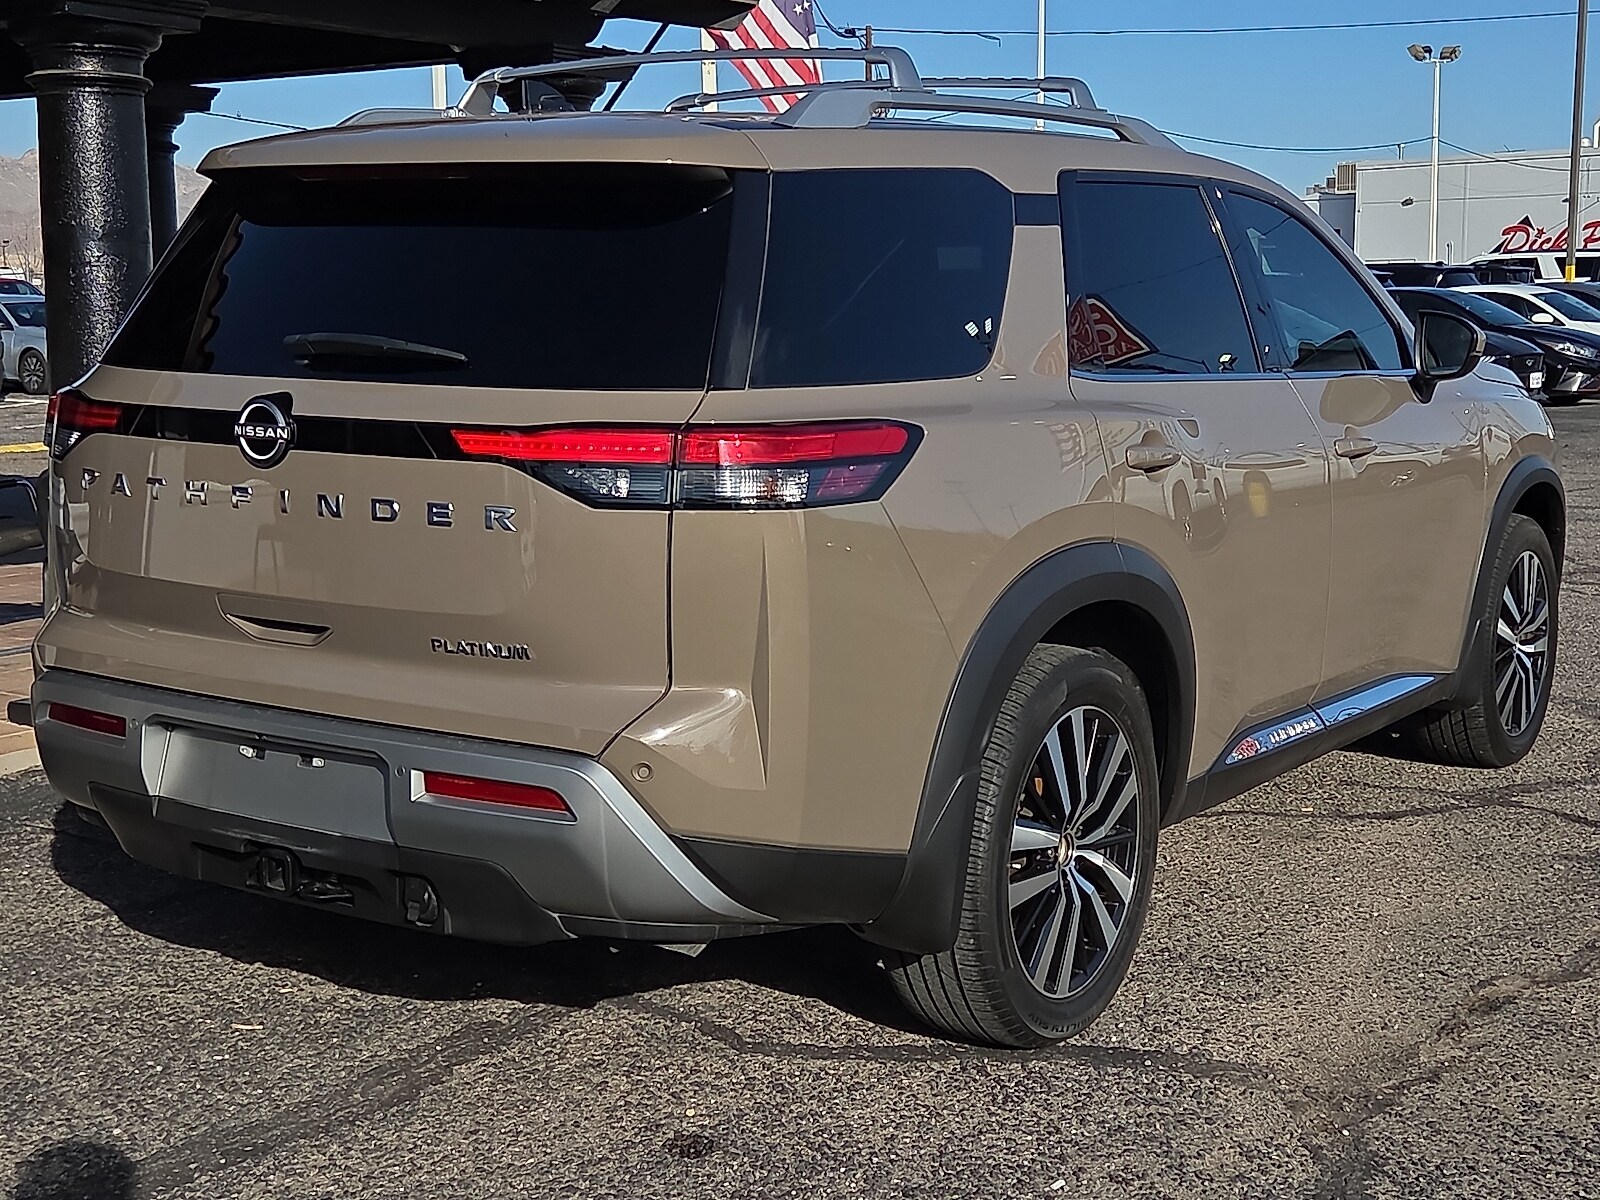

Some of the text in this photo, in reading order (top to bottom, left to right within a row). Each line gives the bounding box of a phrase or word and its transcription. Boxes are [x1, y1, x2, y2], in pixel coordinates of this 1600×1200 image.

[234, 424, 288, 440] NISSAN
[81, 467, 519, 533] PATHFINDER
[430, 637, 532, 661] PLATINUM
